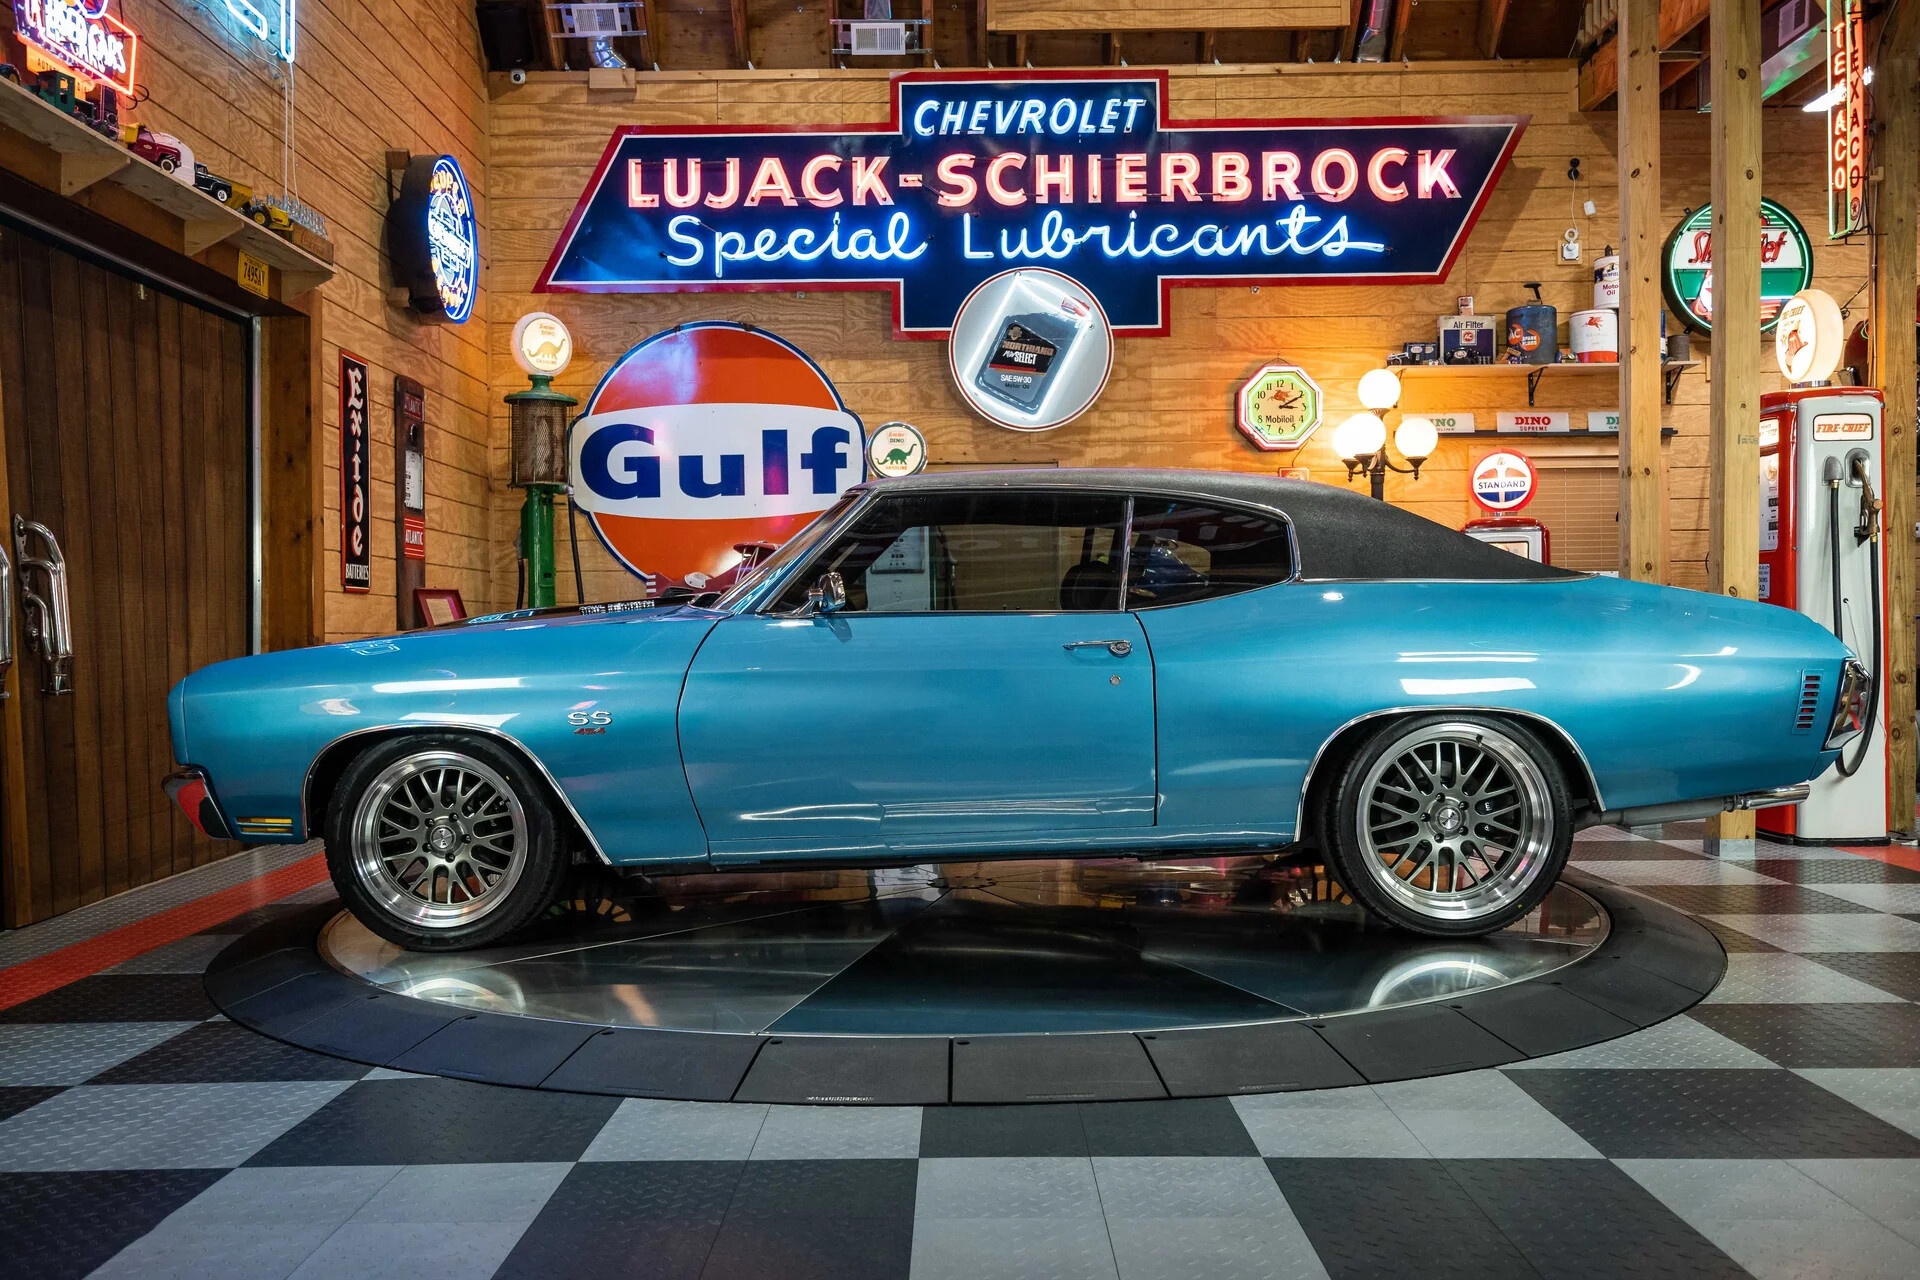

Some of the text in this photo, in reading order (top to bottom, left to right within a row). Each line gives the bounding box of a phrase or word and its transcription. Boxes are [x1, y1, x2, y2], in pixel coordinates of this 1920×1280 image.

[914, 98, 1146, 135] CHEVROLET
[628, 147, 1462, 207] LUJACK-SCHIERBROCK
[664, 205, 1385, 277] Special Lubricants
[1688, 231, 1712, 264] Sk
[1453, 321, 1484, 329] Air Filter
[1000, 374, 1032, 384] SAE 5W-30
[1276, 380, 1285, 388] 12
[1258, 390, 1266, 399] 10
[1265, 415, 1295, 424] Mobiloil
[1430, 418, 1456, 427] INO
[1514, 416, 1551, 425] DINO
[1816, 423, 1871, 433] FIRE-CHIEF
[348, 367, 363, 556] Exide
[579, 423, 850, 501] Gulf
[1478, 480, 1526, 489] STANDARD
[405, 530, 424, 546] ATLANTIC
[345, 563, 369, 580] BATTERIES
[567, 710, 612, 726] SS
[573, 727, 606, 735] 454
